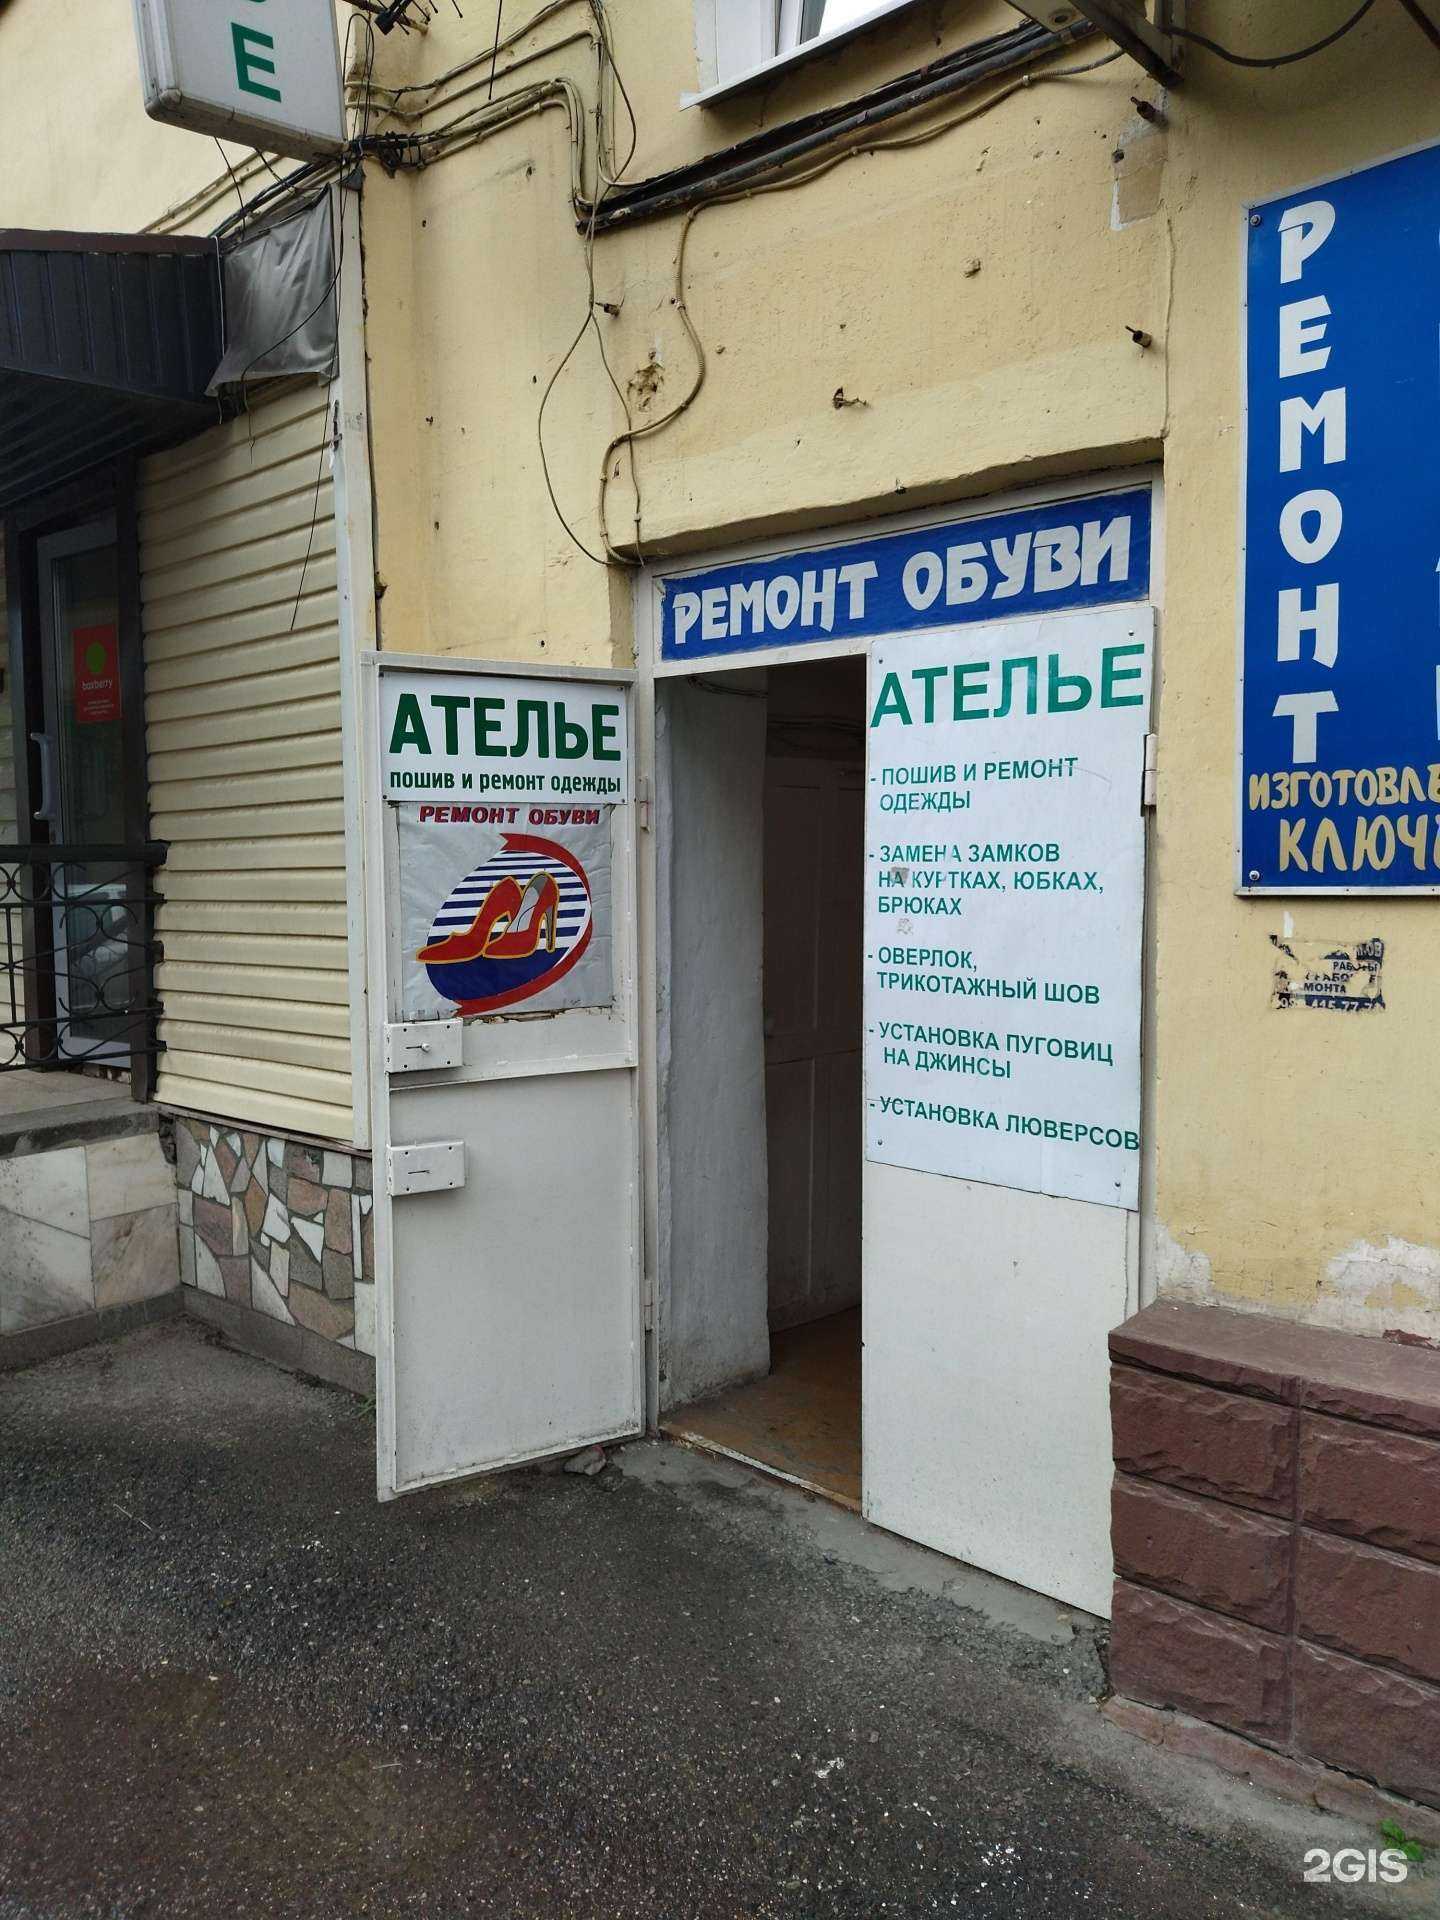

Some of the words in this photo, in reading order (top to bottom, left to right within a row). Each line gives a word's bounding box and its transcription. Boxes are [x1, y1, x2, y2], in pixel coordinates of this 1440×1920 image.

[231, 0, 281, 103] Е
[1272, 201, 1346, 763] РЕМОНТ
[673, 560, 879, 645] РЕМОНТ
[902, 515, 1132, 611] ОБУВИ
[871, 644, 1145, 728] АТЕЛЬЕ
[389, 693, 621, 761] АТЕЛЬЕ
[390, 771, 455, 789] пошив
[462, 774, 473, 789] и
[480, 774, 545, 793] ремонт
[551, 775, 621, 795] одежды
[882, 765, 956, 785] ПОШИВ
[964, 763, 977, 781] И
[984, 757, 1078, 780] РЕМОНТ
[419, 806, 520, 824] РЕМОНТ
[528, 808, 601, 825] ОБУВИ
[880, 791, 970, 814] ОДЕЖДЫ
[880, 845, 962, 862] ЗАМЕНА
[968, 844, 1060, 862] ЗАМКОВ
[879, 871, 904, 887] НА
[1014, 872, 1104, 894] ЮБКАХ,
[878, 897, 962, 915] БРЮКАХ
[878, 947, 977, 972] ОВЕРЛОК,
[877, 972, 1037, 999] ТРИКОТАЖНЫЙ
[1044, 983, 1100, 1004] ШОВ
[879, 1022, 999, 1050] УСТАНОВКА
[1007, 1034, 1113, 1066] ПУГОВИЦ
[884, 1047, 910, 1066] НА
[915, 1051, 1011, 1078] ДЖИНСЫ
[880, 1096, 999, 1130] УСТАНОВКА
[1005, 1114, 1139, 1151] ЛЮВЕРСОВ
